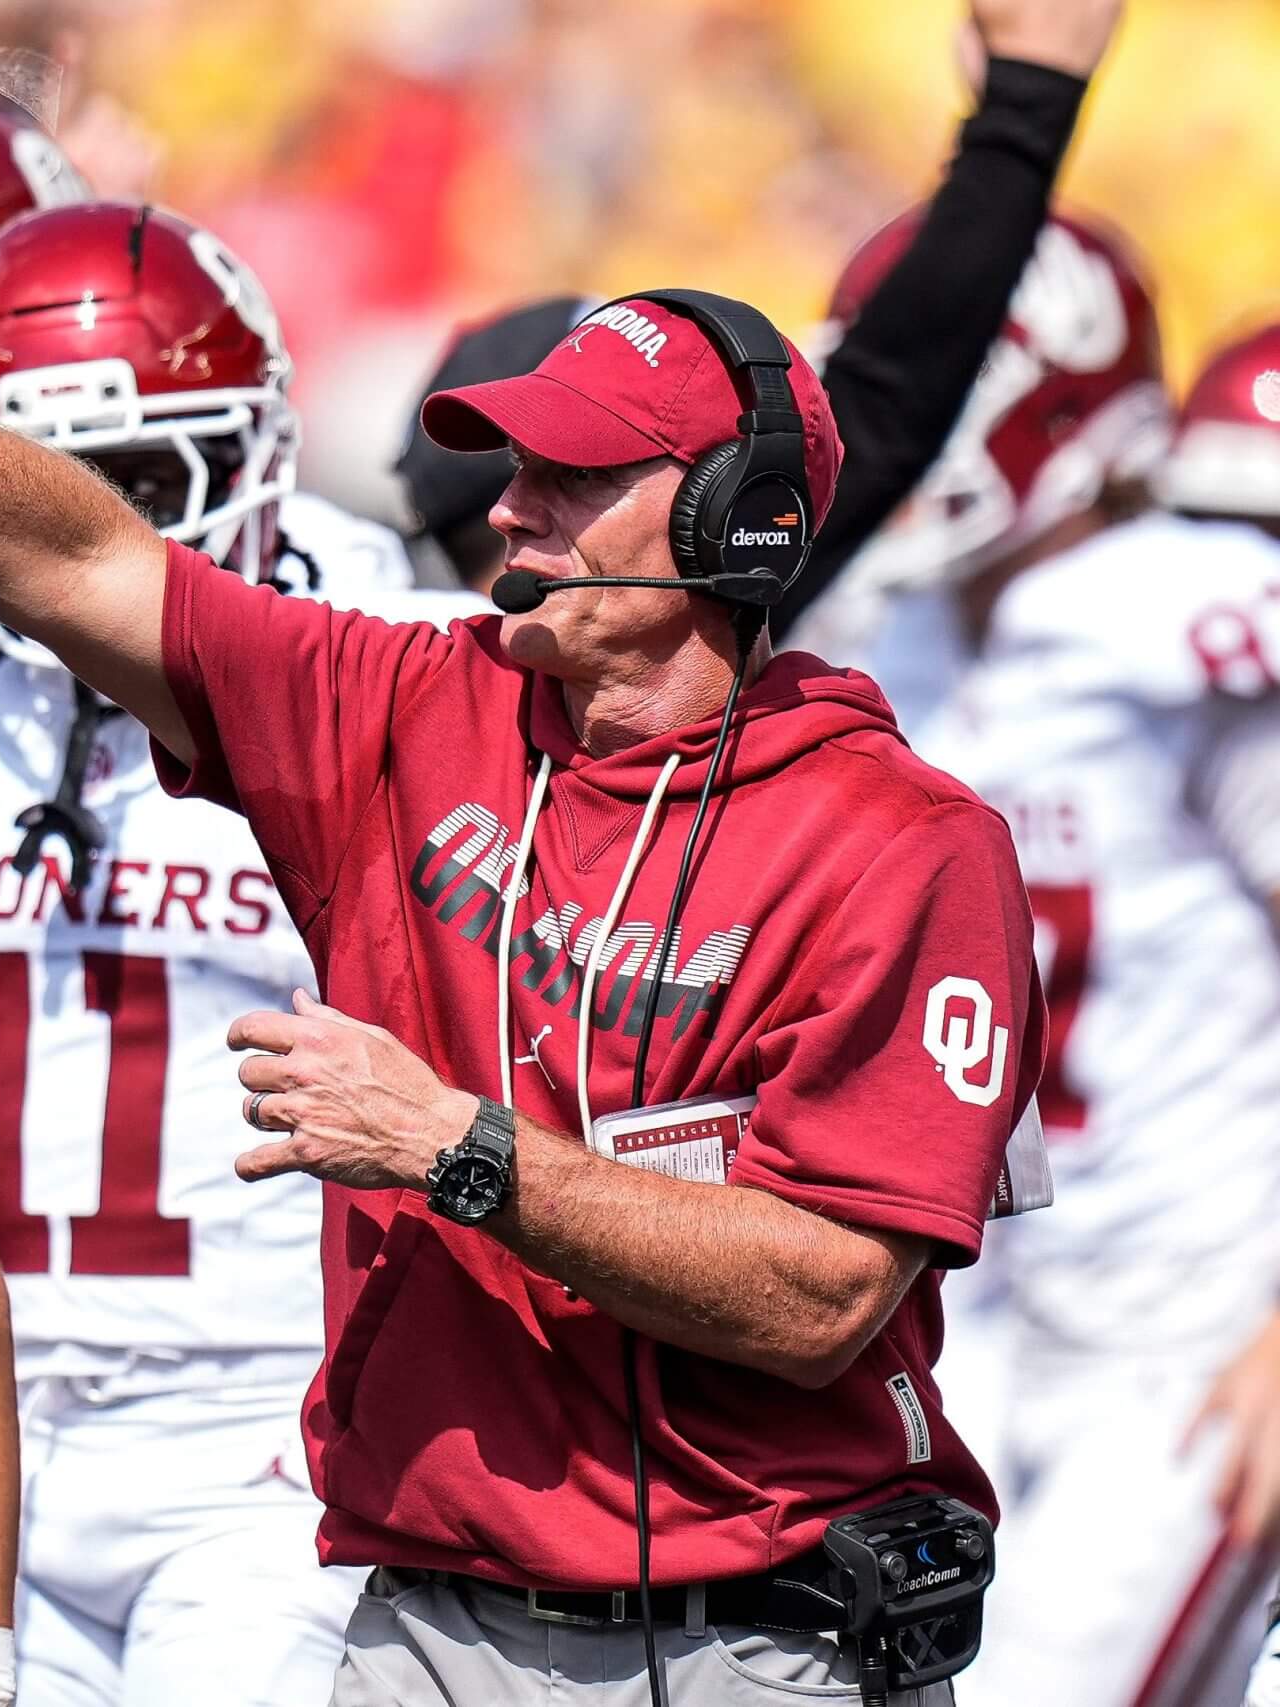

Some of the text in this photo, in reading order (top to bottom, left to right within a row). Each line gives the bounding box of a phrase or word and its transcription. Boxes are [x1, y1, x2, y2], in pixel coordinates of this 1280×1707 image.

[580, 305, 668, 362] HOMA
[731, 528, 791, 546] devon
[922, 975, 1009, 1107] OU
[897, 1566, 961, 1594] CoachComm
